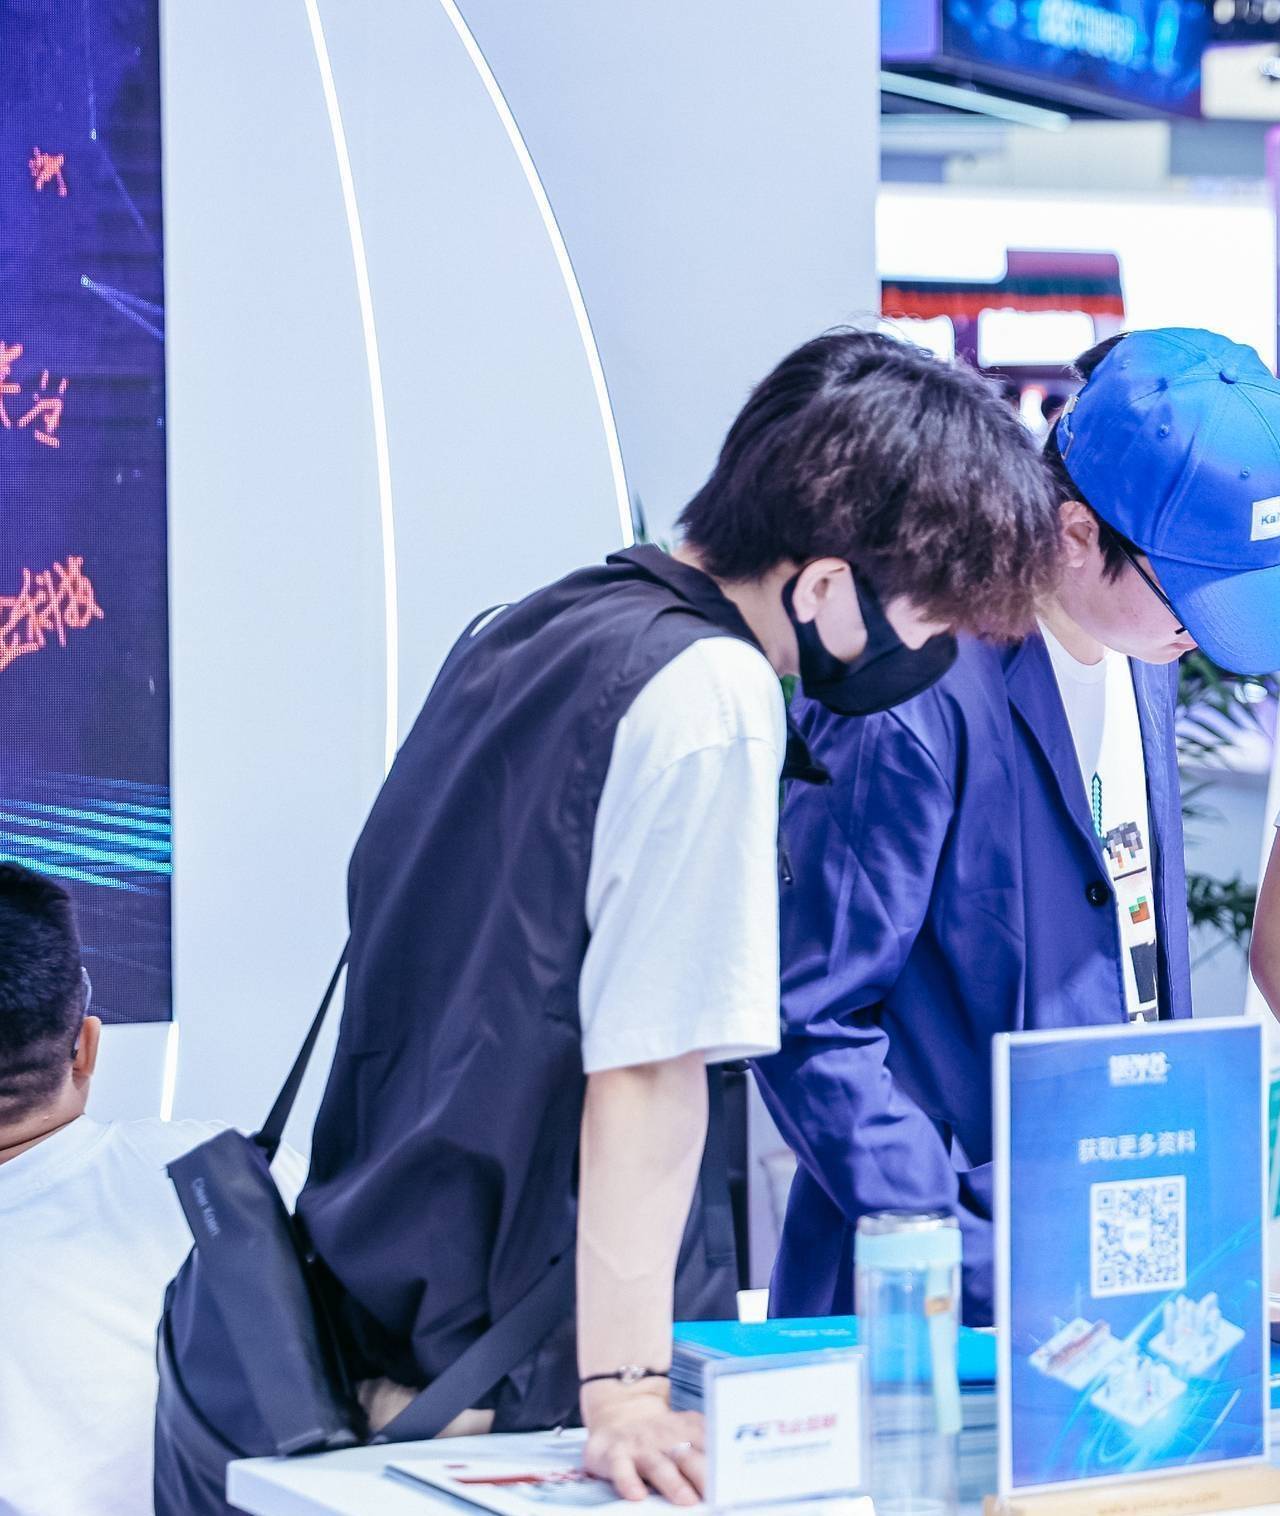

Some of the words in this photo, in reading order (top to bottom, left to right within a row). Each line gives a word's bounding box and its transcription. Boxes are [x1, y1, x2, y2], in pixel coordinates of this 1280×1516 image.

[1079, 1130, 1196, 1163] 获取更多资料
